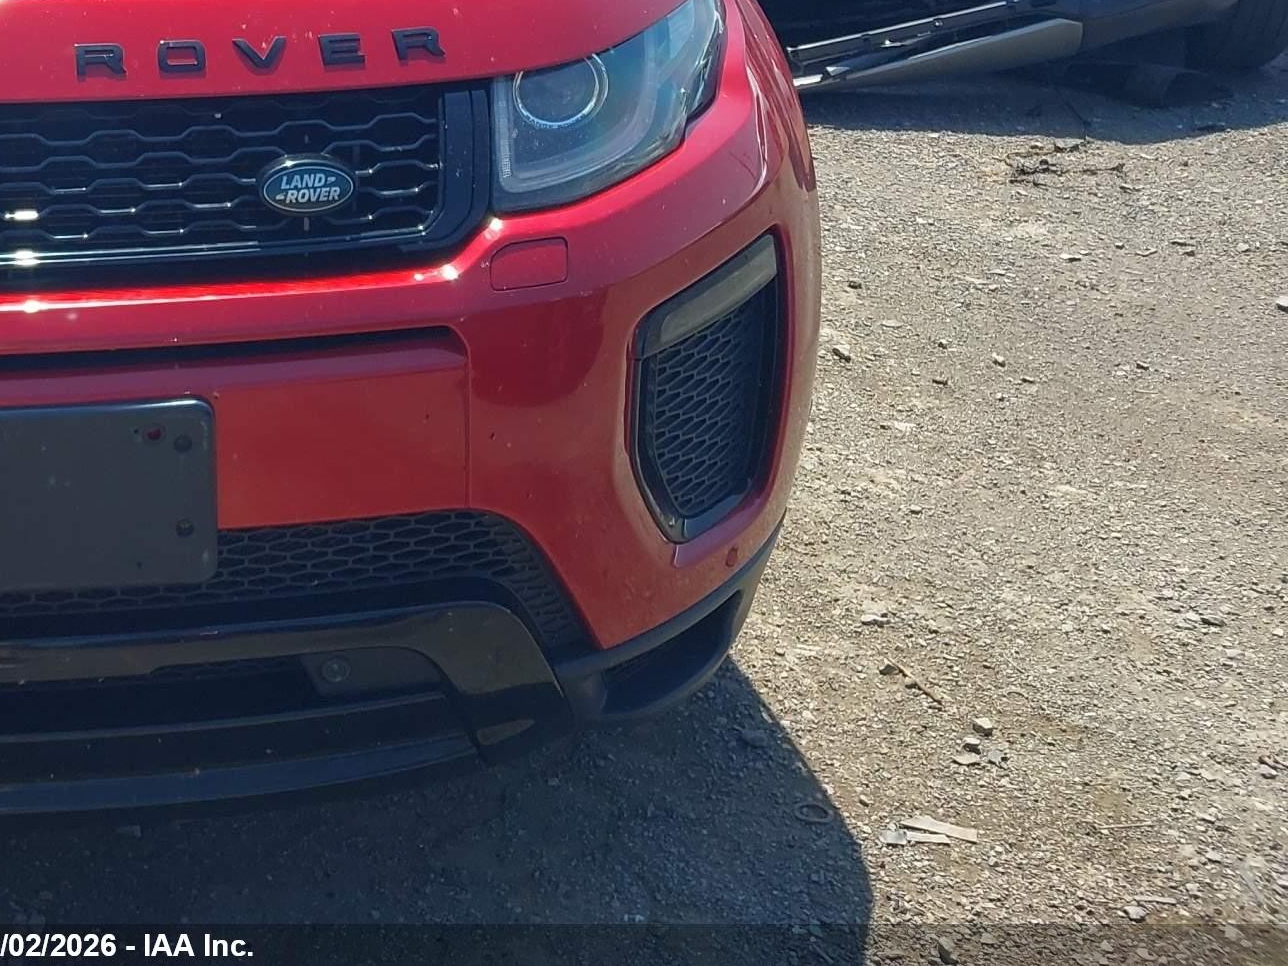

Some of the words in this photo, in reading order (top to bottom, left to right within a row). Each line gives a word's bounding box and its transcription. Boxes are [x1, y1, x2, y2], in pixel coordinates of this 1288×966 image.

[74, 25, 447, 82] ROVER
[280, 173, 327, 190] LAND
[285, 186, 341, 204] ROVER
